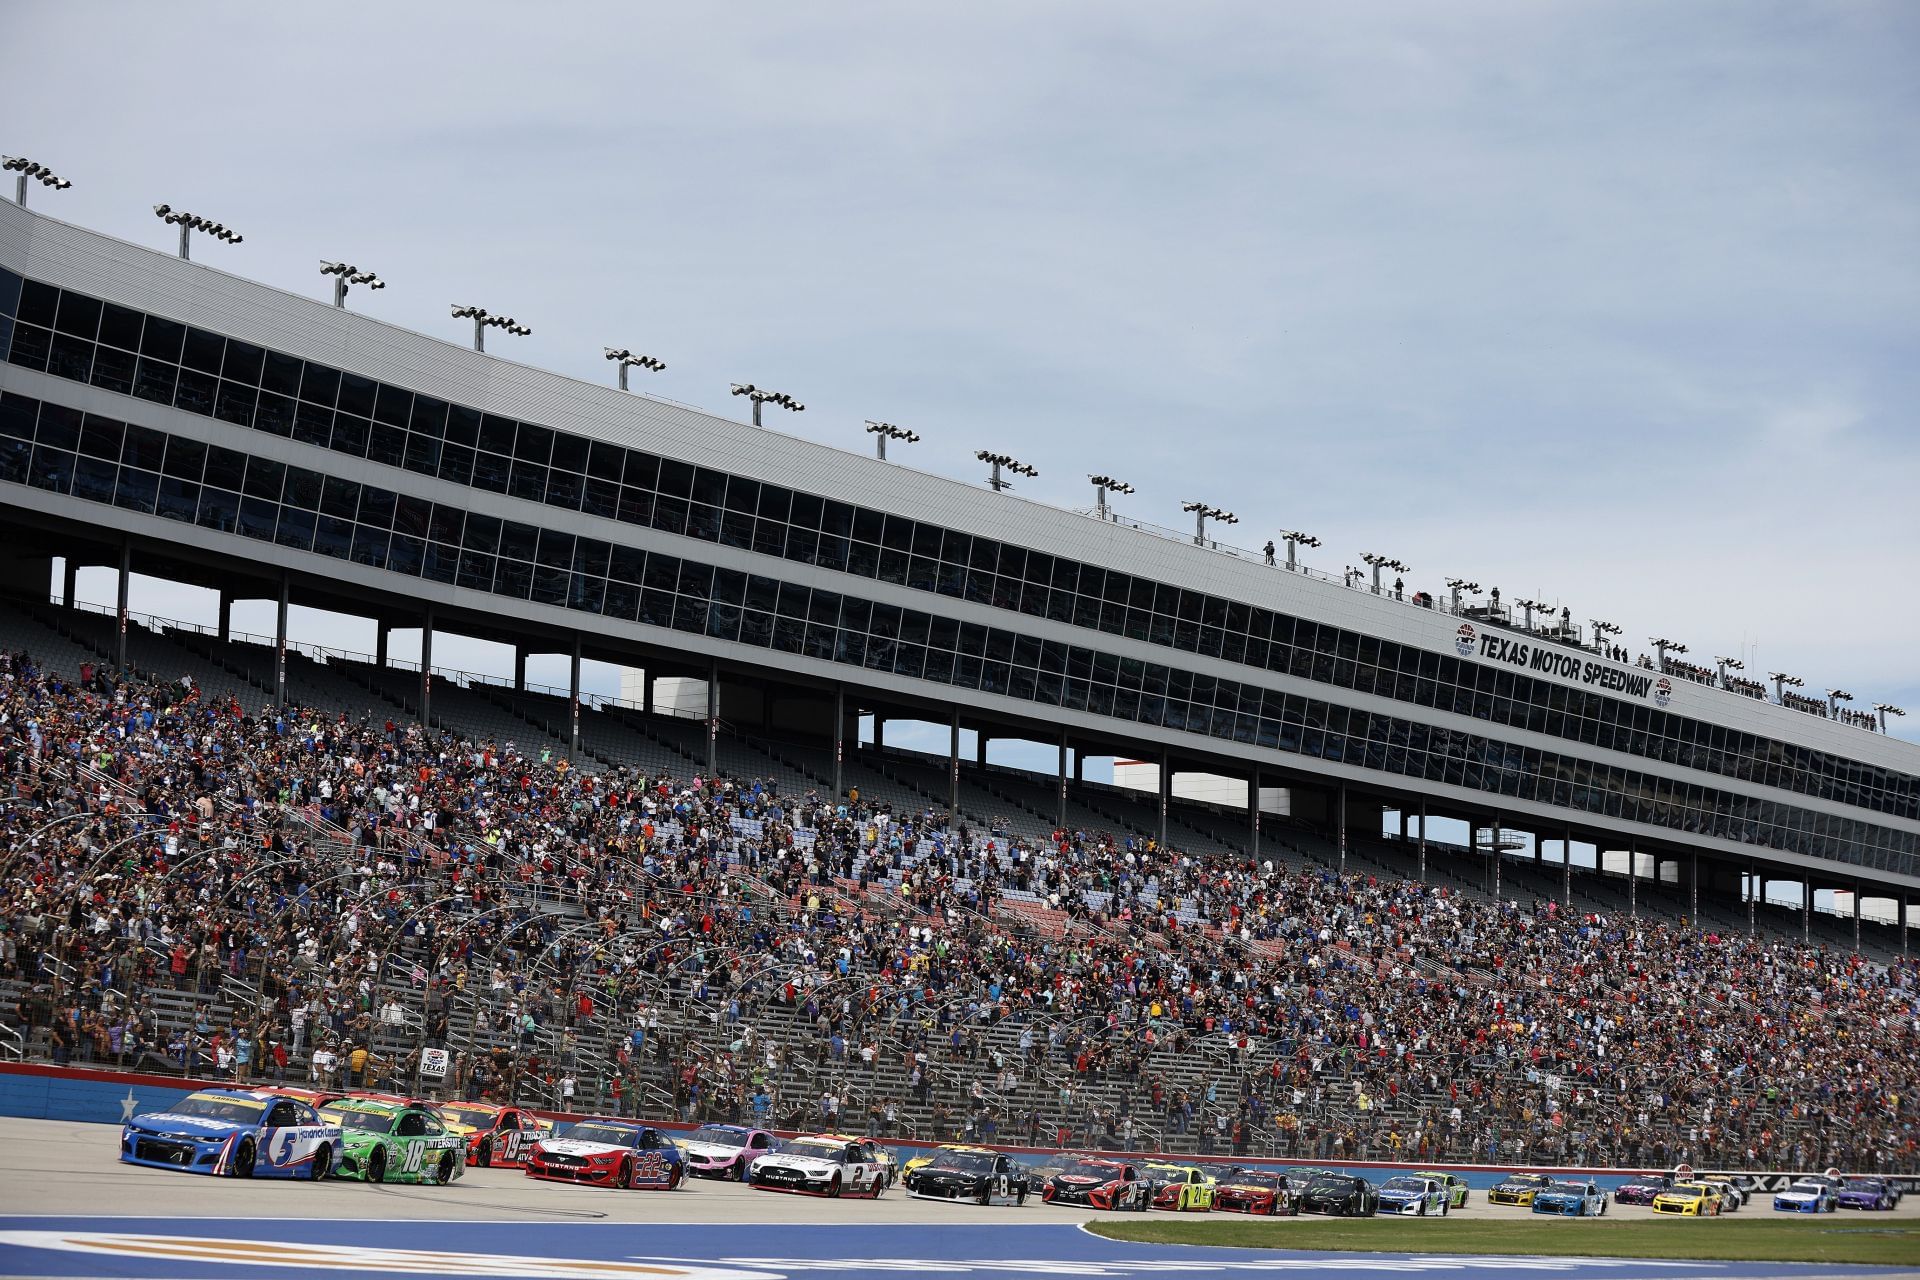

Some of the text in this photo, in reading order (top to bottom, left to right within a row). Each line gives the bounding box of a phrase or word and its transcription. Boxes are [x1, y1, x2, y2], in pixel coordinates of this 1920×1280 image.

[1480, 634, 1653, 698] TEXAS MOTOR SPEEDWAY
[422, 1063, 445, 1073] TEXAS
[274, 1132, 298, 1167] 5
[401, 1139, 426, 1173] 18
[503, 1132, 521, 1159] 19
[544, 1161, 580, 1171] MUSTANG
[640, 1151, 662, 1179] 22
[765, 1174, 800, 1182] MUSTANG
[850, 1165, 863, 1190] 2
[1000, 1174, 1008, 1198] 8
[1193, 1186, 1202, 1204] 21
[1281, 1190, 1289, 1208] 3
